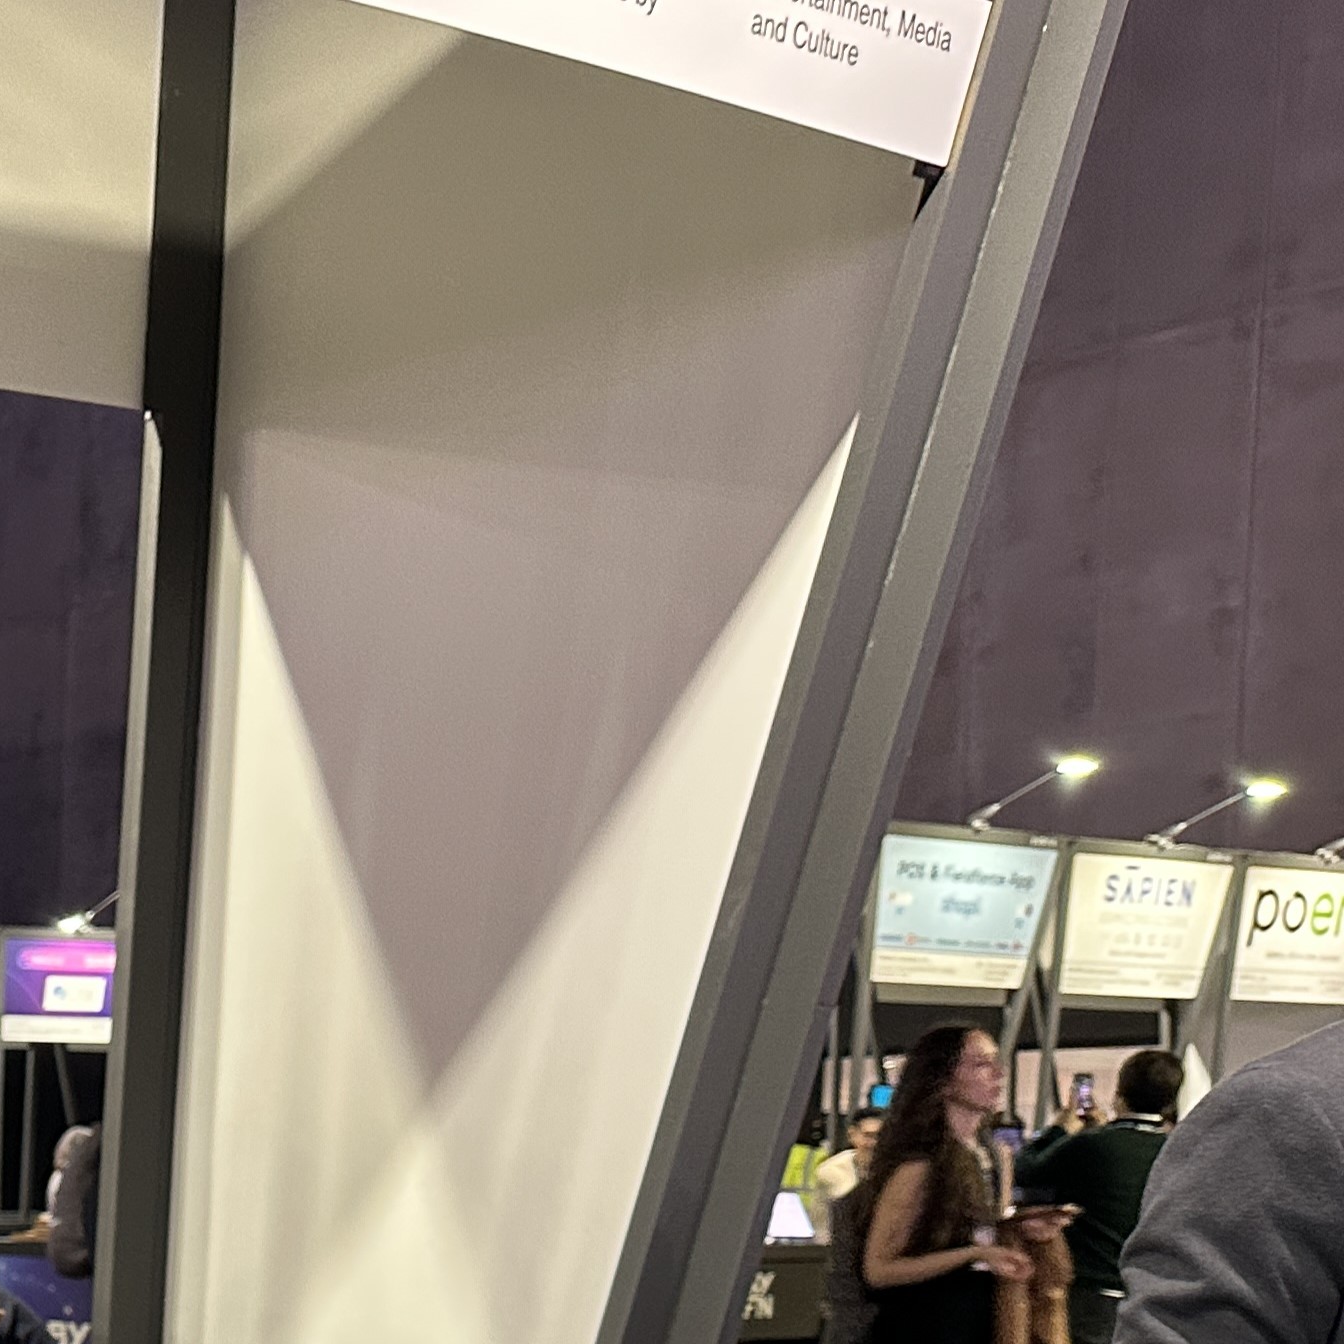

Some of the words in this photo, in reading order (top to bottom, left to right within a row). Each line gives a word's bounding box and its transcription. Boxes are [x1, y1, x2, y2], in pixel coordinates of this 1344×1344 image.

[751, 13, 789, 43] and
[792, 20, 859, 66] Culture
[897, 10, 952, 52] Media
